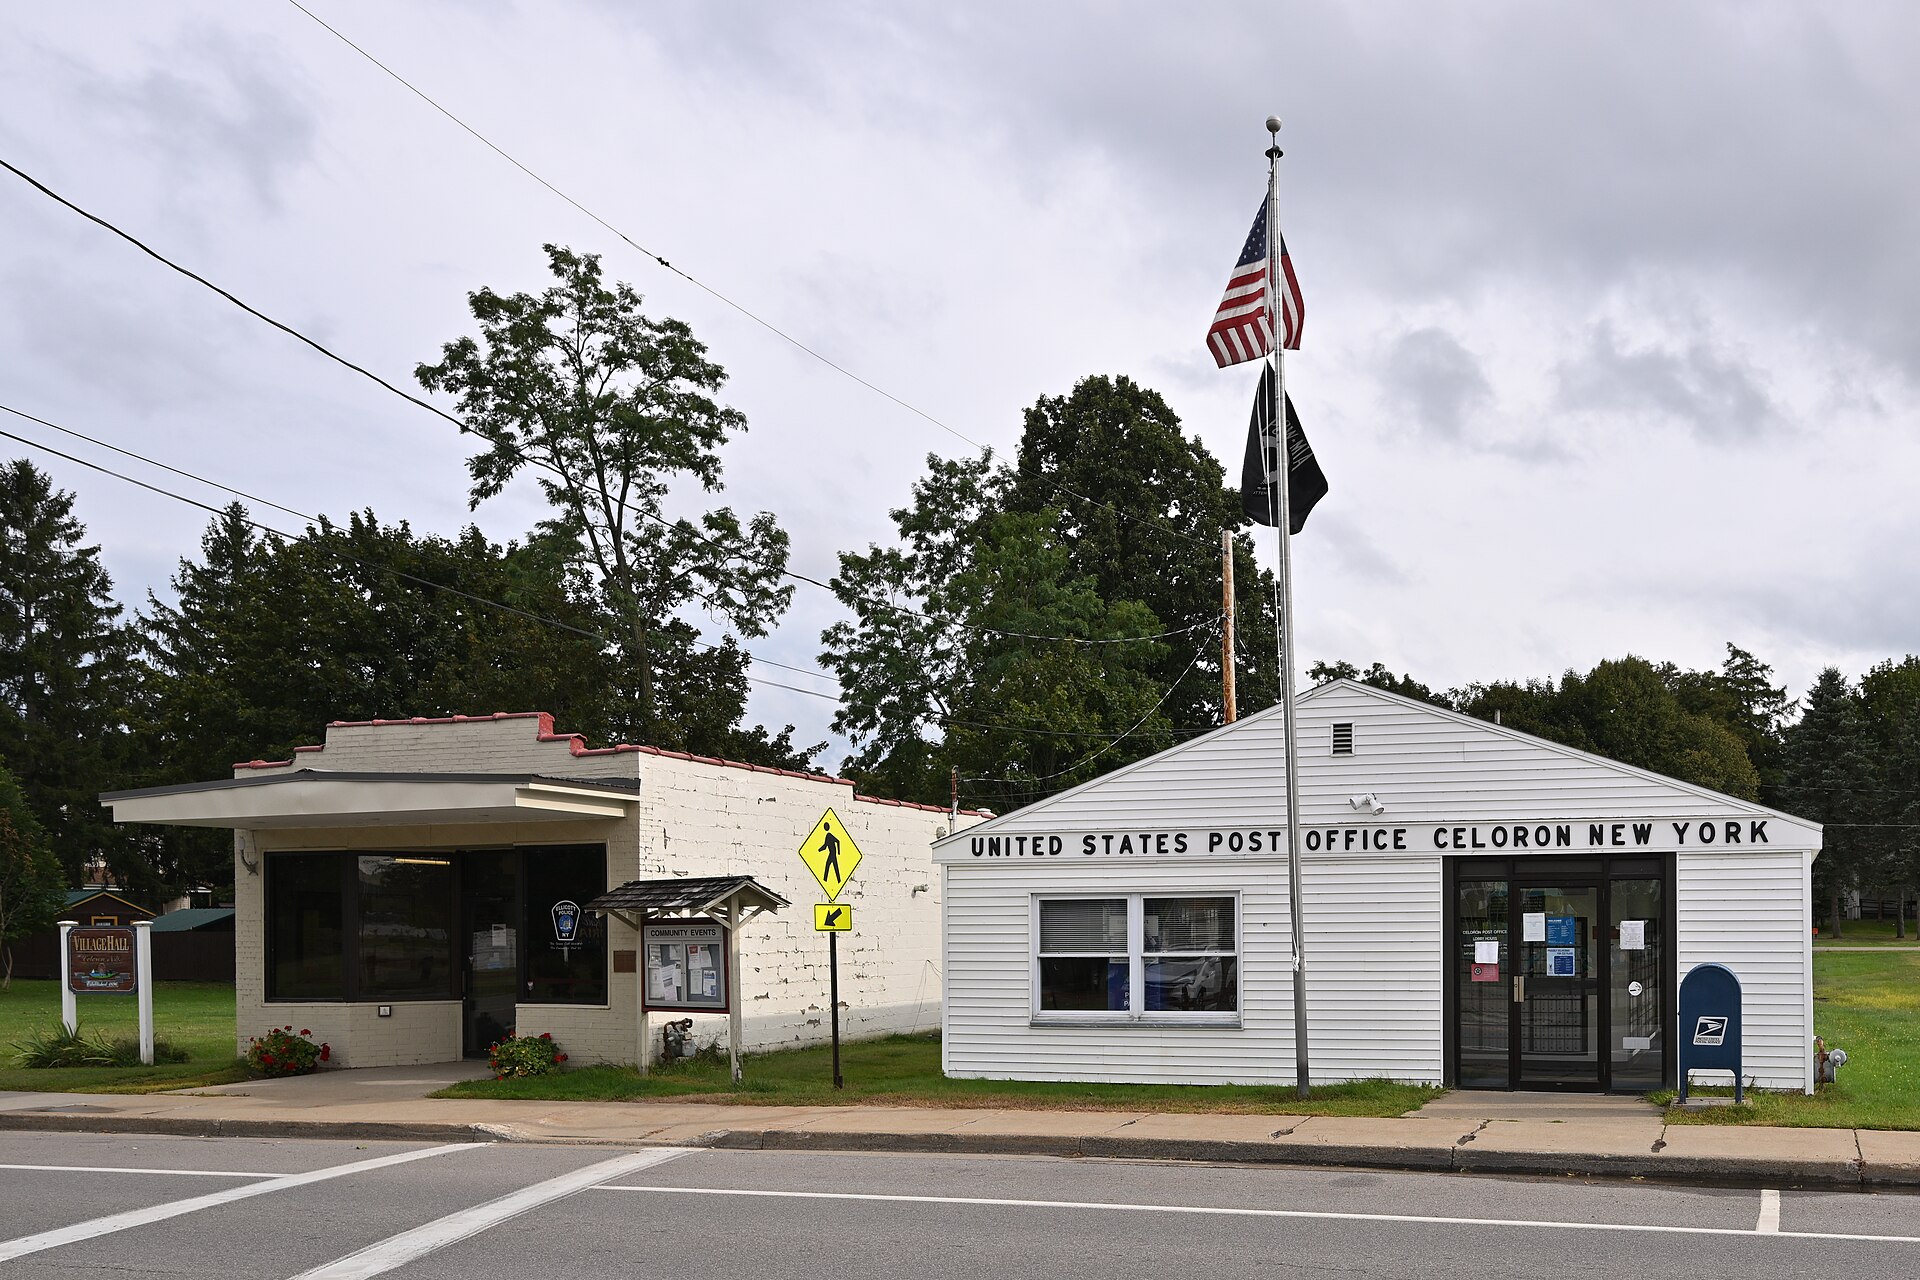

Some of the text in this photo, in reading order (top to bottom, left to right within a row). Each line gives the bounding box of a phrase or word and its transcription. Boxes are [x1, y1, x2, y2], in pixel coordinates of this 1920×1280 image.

[1289, 439, 1313, 472] MIA
[971, 820, 1769, 857] UNITED STATES POST OFFICE CELORON NEW YORK
[73, 935, 130, 951] VILLAGE HALL
[650, 928, 717, 937] COMMUNITY EVENTS
